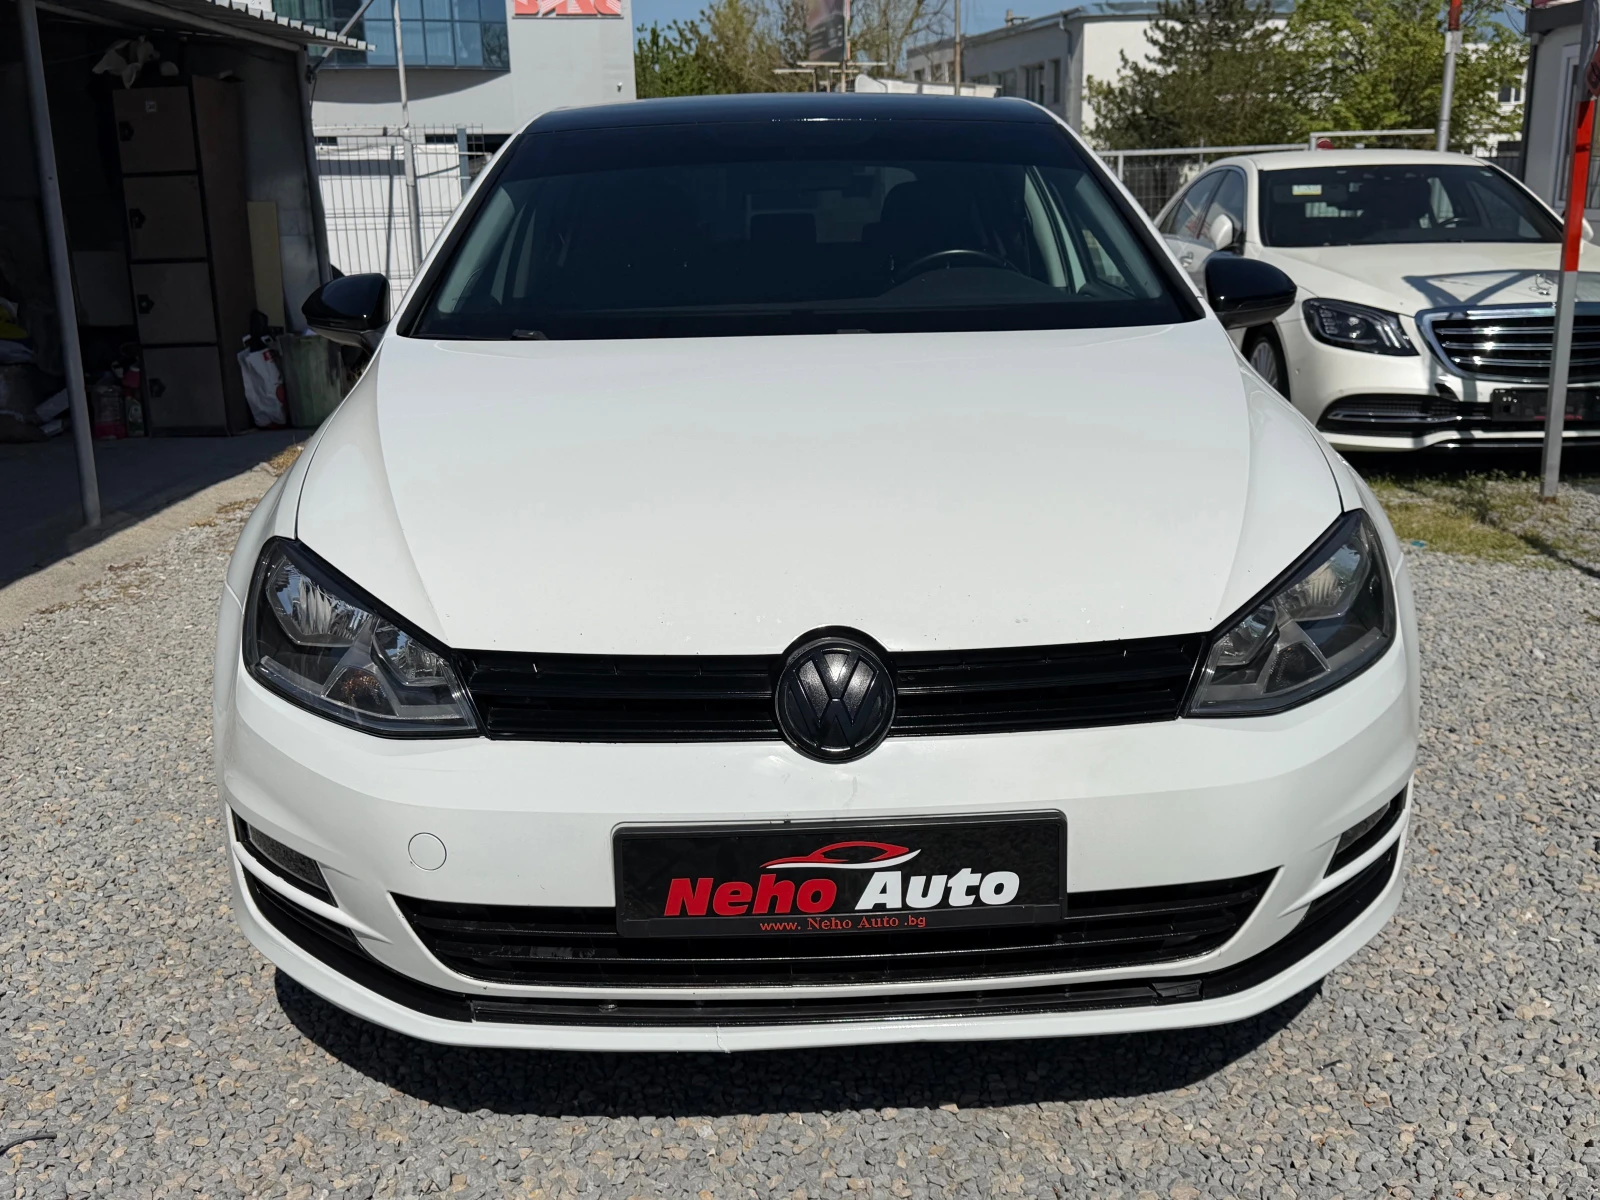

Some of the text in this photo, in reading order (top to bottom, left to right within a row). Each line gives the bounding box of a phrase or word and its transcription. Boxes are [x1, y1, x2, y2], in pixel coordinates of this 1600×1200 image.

[664, 867, 1020, 917] Neho Auto
[759, 914, 927, 931] www. Neho Auto .bg
